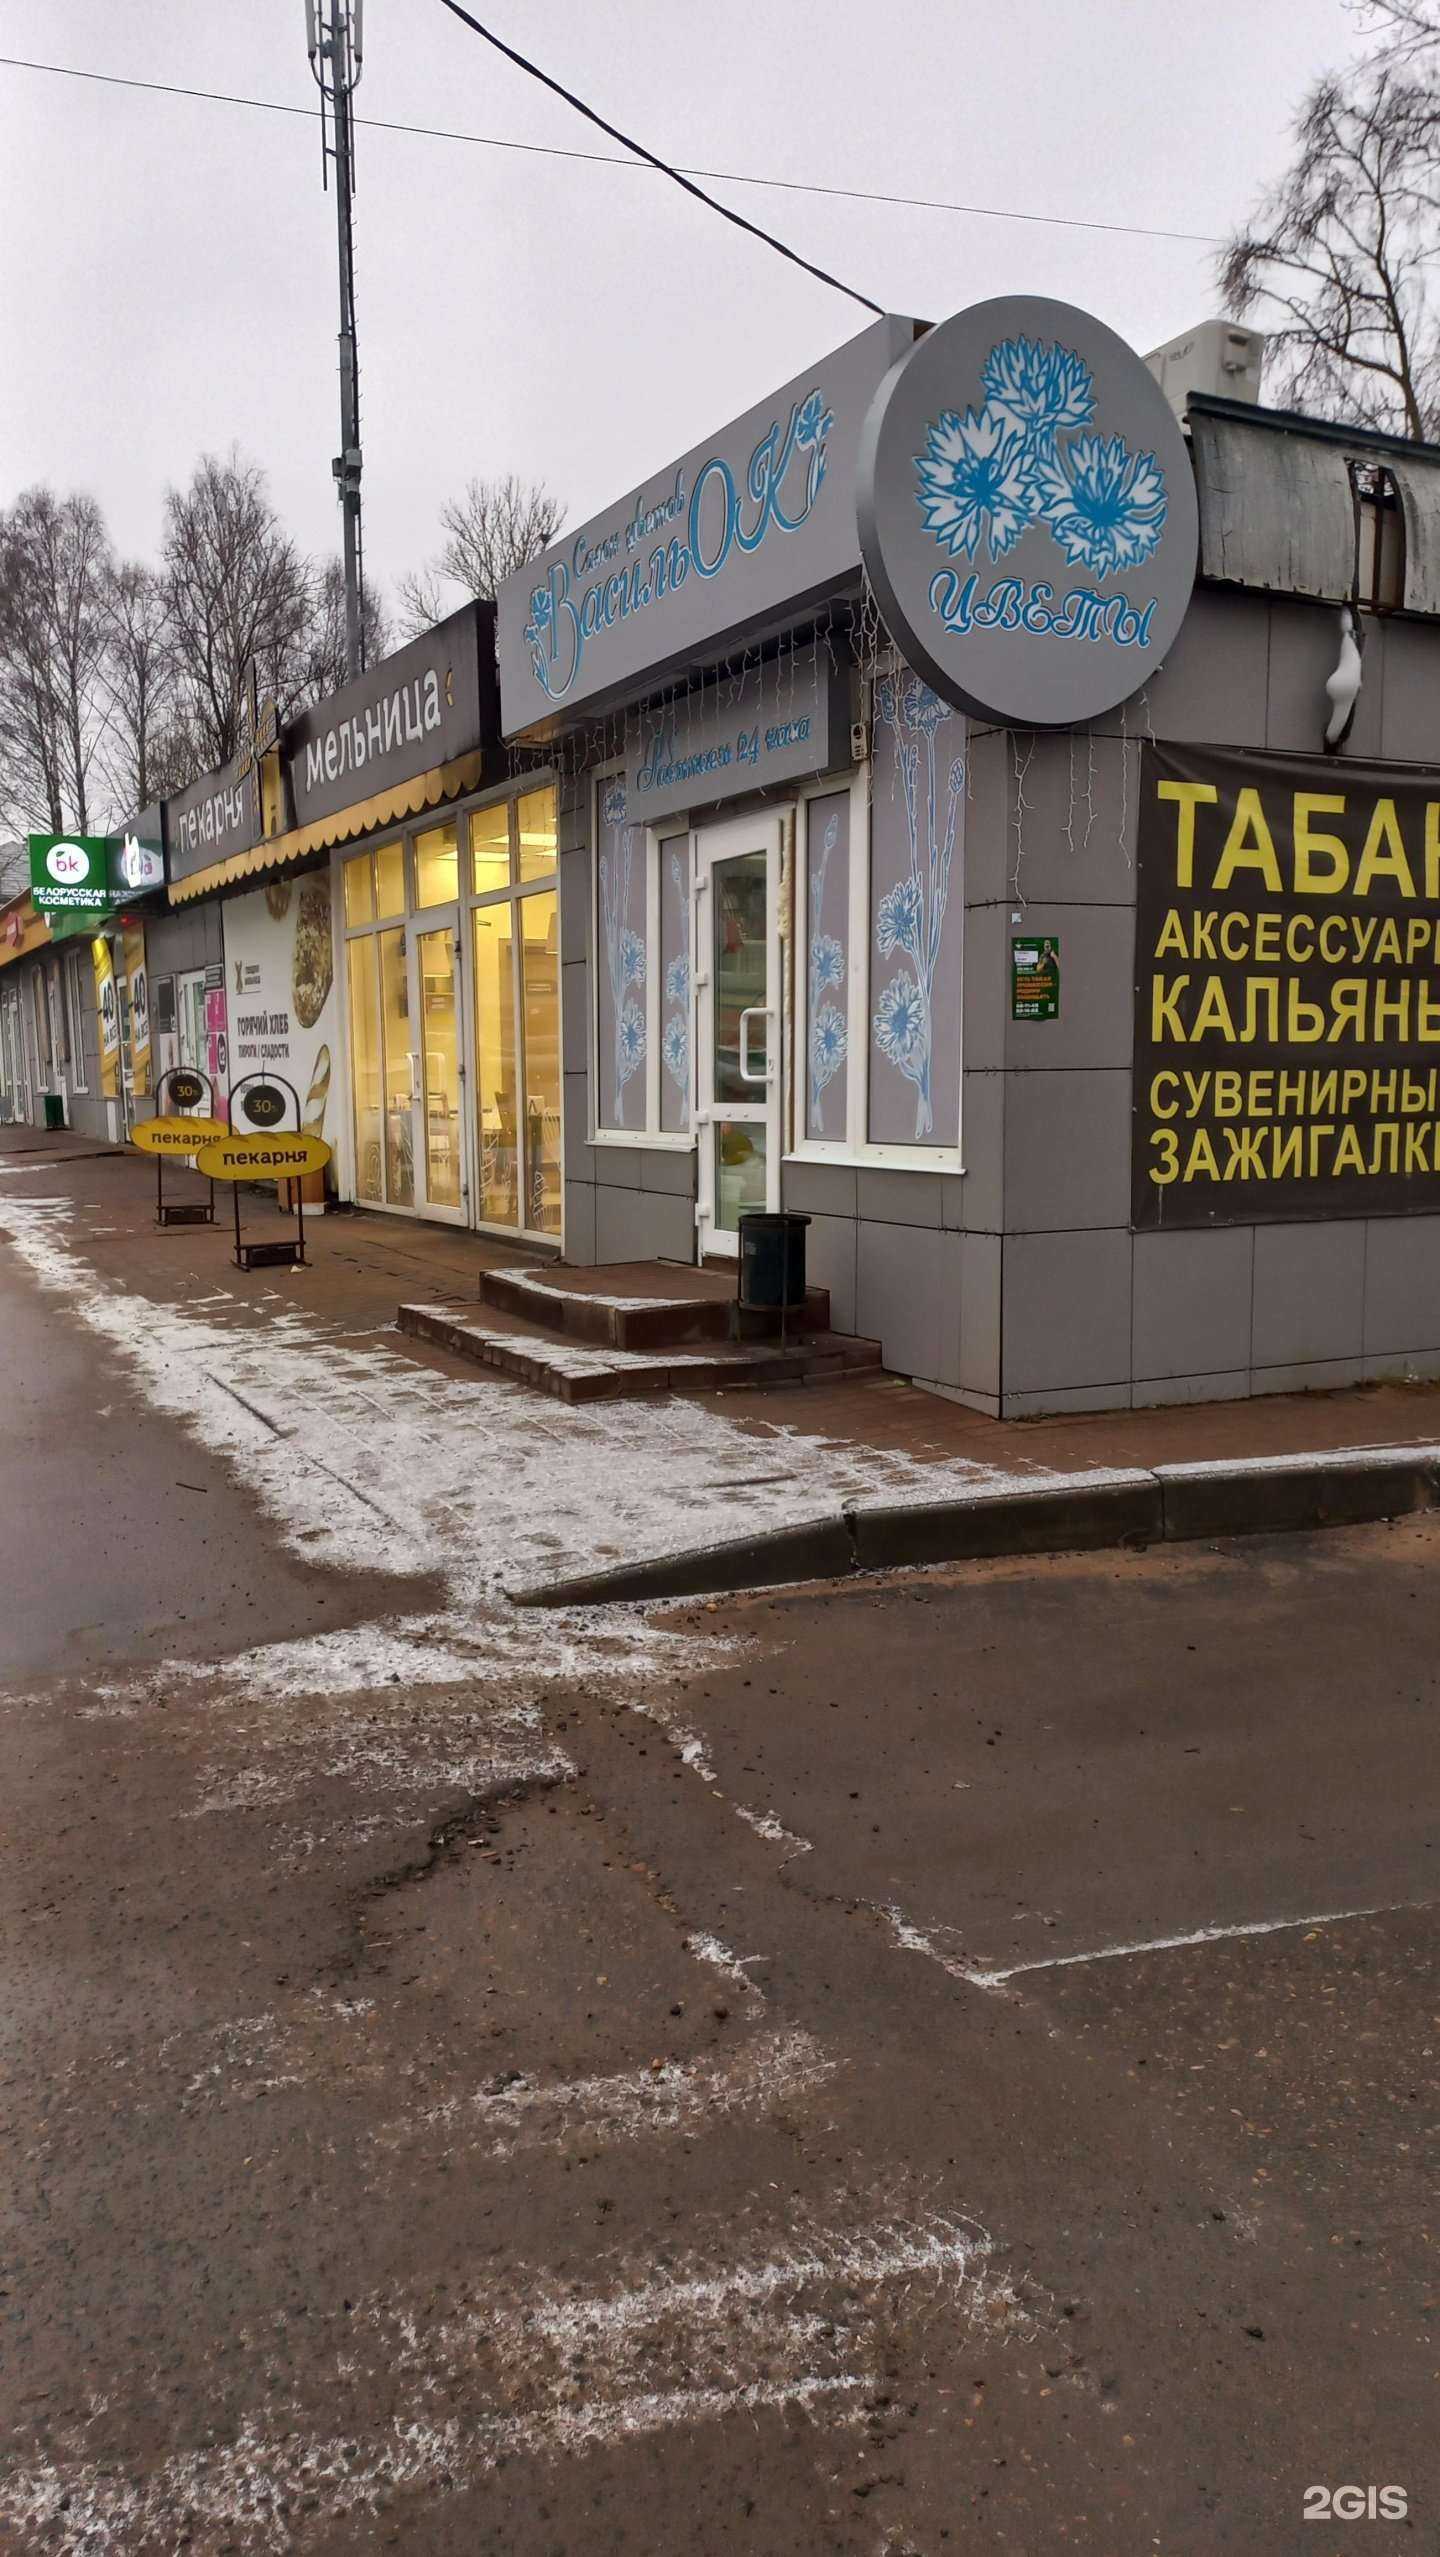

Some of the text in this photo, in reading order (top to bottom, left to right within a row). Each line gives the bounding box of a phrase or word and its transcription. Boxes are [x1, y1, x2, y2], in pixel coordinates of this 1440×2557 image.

[305, 669, 441, 793] мельница
[178, 784, 245, 854] пекарня
[1157, 780, 1440, 899] ТАБА
[33, 886, 107, 899] БЕЛОРУССКАЯ
[38, 895, 102, 907] КОСМЕТИКА
[1154, 909, 1440, 964] АКСЕССУАР
[237, 1009, 268, 1036] ГОРЯЧИЙ
[269, 1013, 289, 1034] ХЛЕБ
[222, 1150, 308, 1167] пекарня
[1148, 1121, 1440, 1185] ЗАЖИГАЛК
